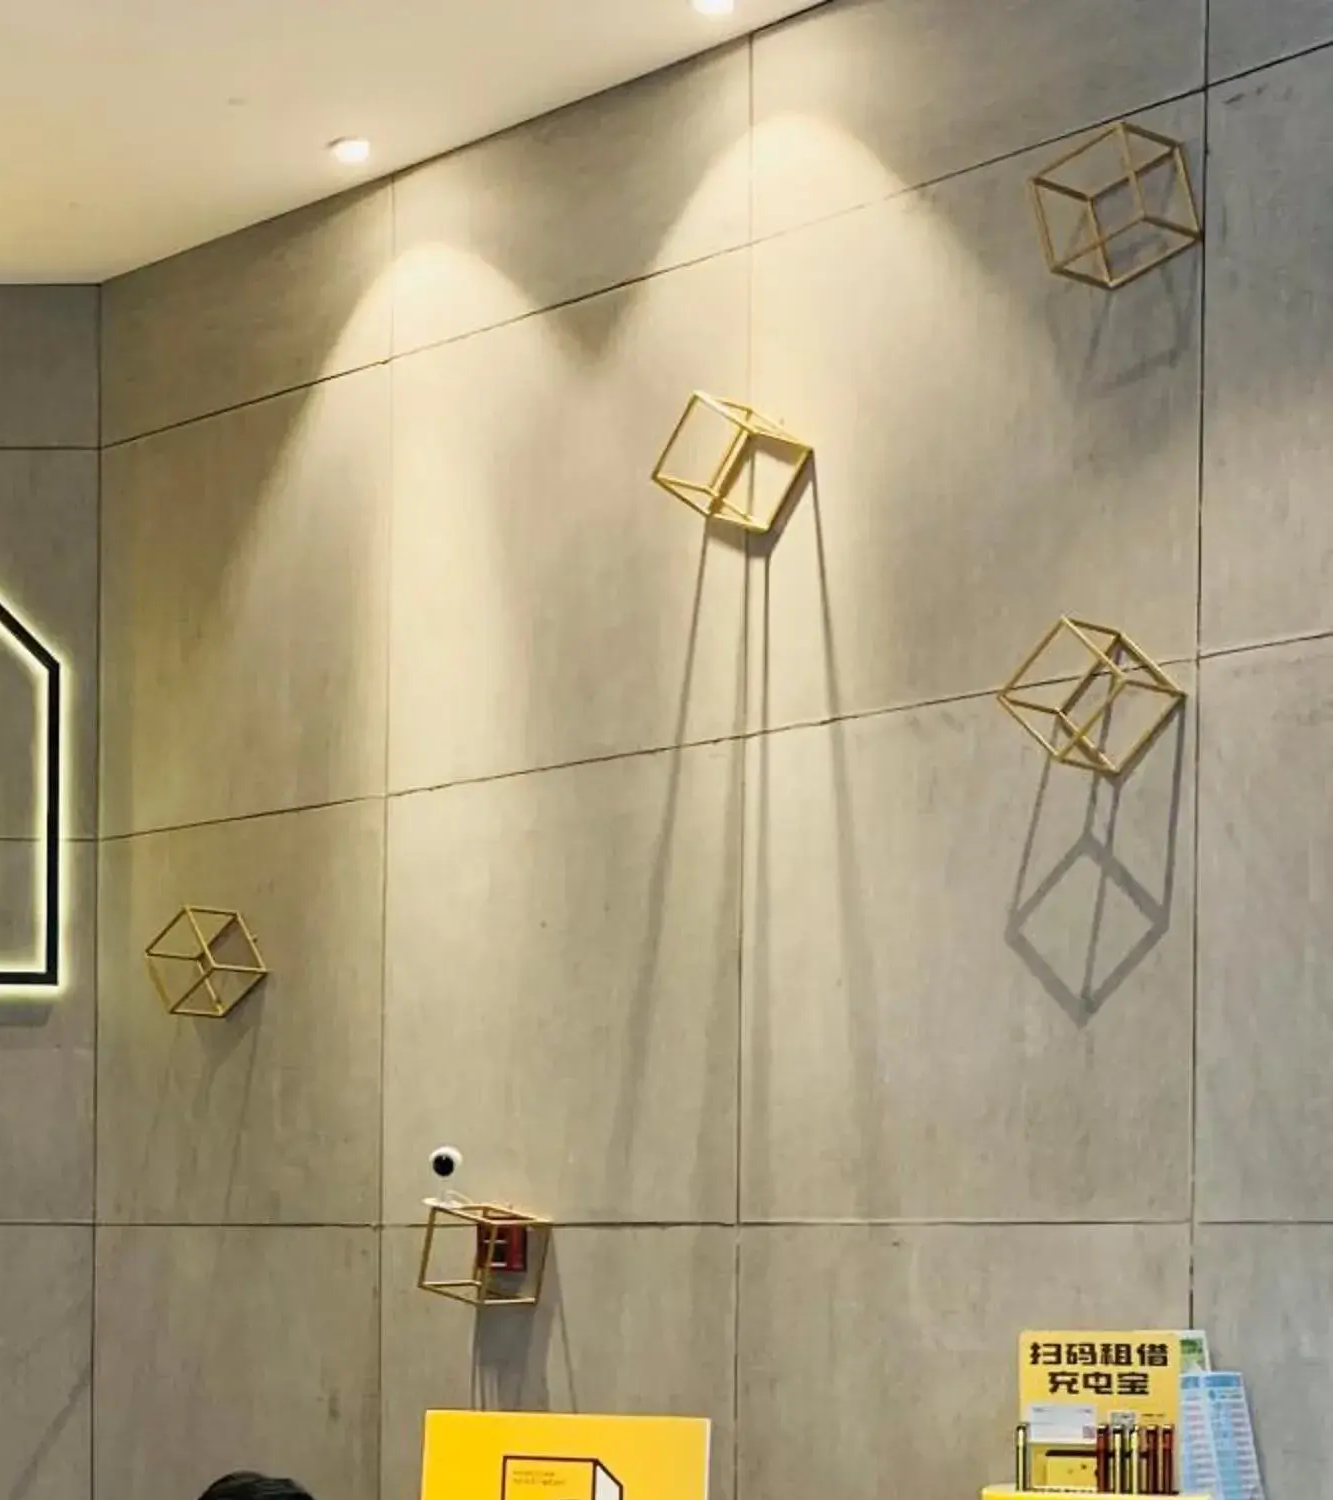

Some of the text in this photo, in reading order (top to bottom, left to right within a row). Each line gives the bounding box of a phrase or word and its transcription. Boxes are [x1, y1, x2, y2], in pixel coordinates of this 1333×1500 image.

[1030, 1342, 1169, 1367] 扫码租借
[1048, 1371, 1150, 1395] 充电宝
